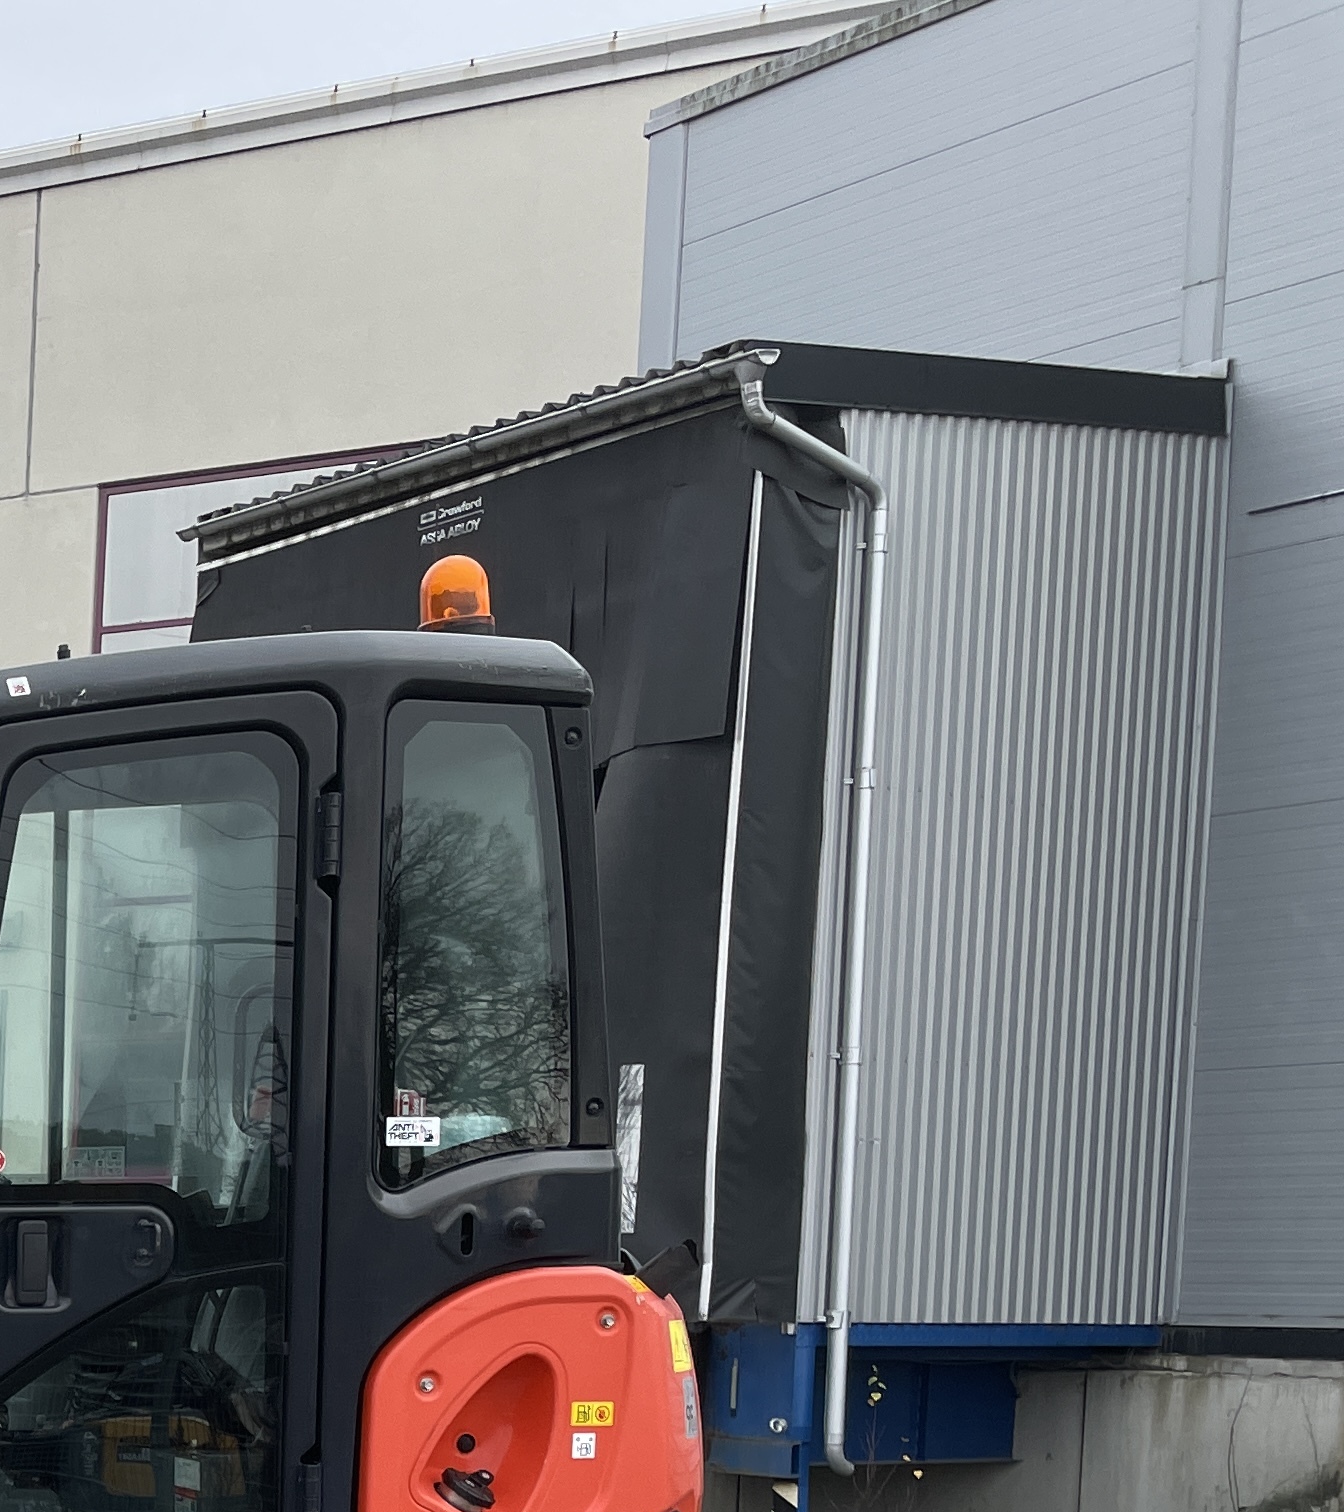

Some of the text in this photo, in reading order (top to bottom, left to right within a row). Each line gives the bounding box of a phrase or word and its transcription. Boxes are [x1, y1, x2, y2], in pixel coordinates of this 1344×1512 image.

[447, 518, 482, 539] ABLOY
[389, 1123, 415, 1131] ANTI
[388, 1132, 419, 1140] THEFT
